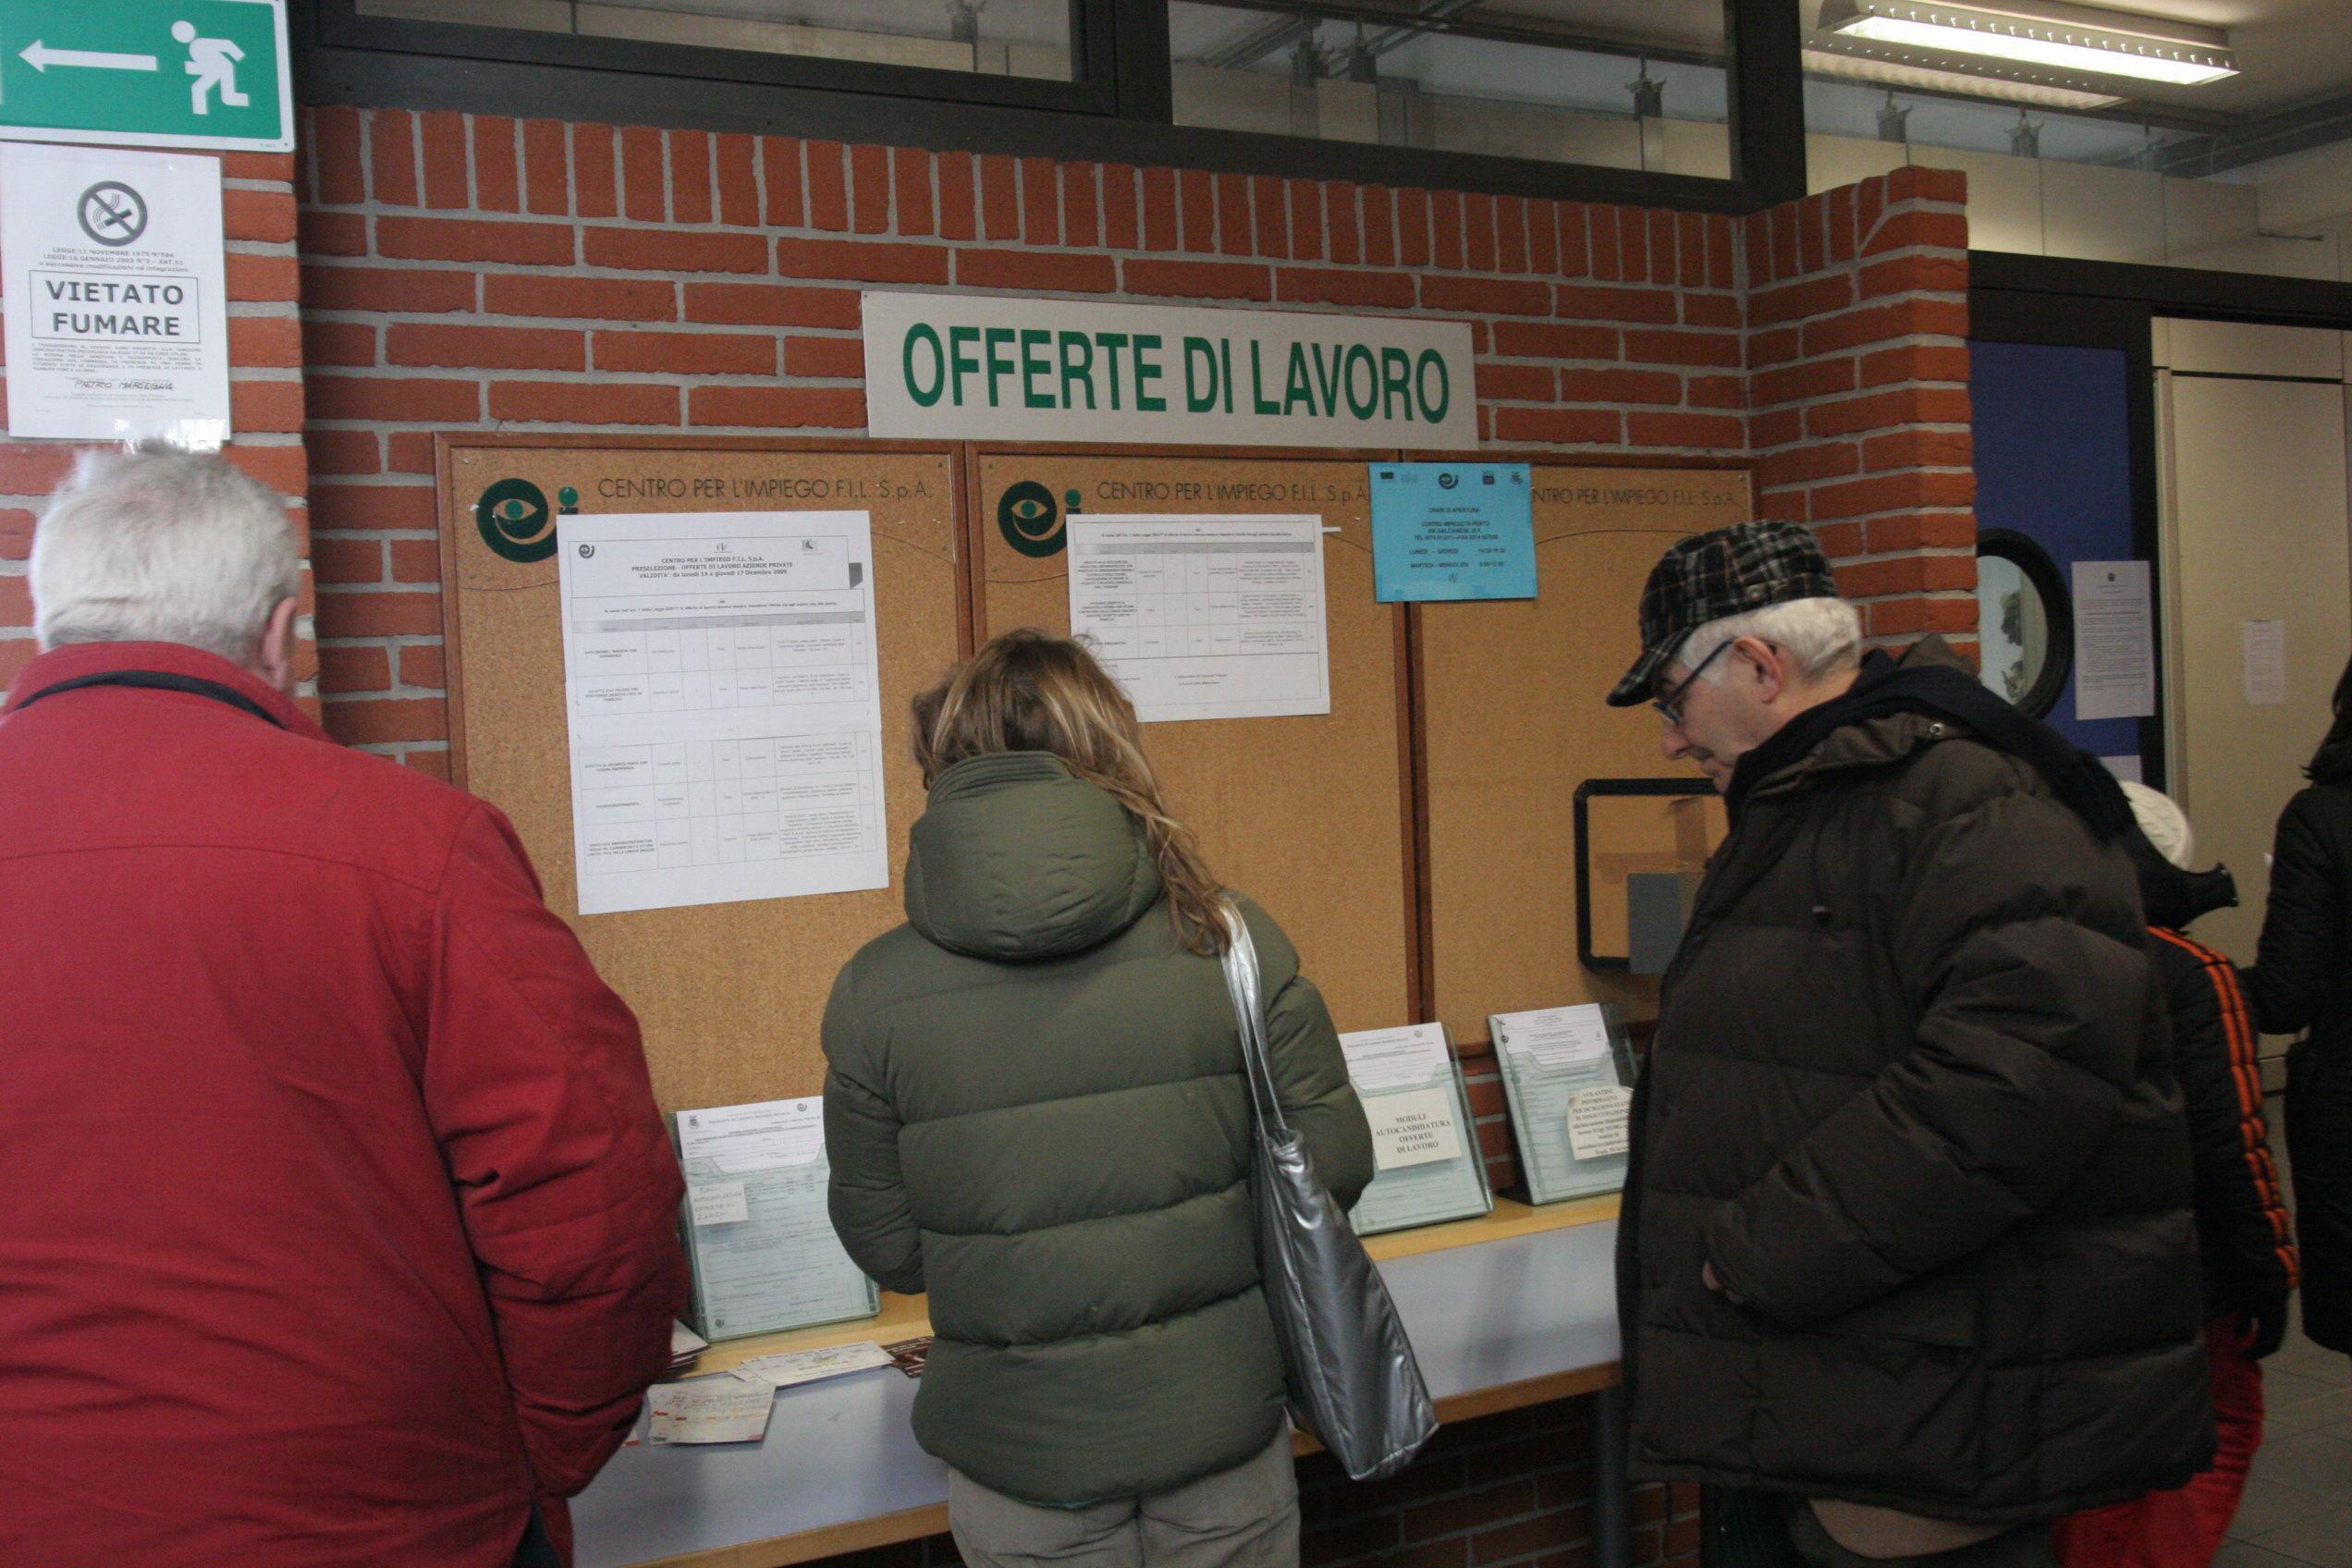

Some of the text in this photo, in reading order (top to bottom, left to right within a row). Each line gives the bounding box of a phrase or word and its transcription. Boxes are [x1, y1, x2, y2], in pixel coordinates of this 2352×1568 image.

[44, 279, 184, 305] VIETATO
[52, 312, 180, 337] FUMARE
[902, 322, 1450, 424] OFFERTE DI LAVORO
[597, 477, 690, 499] CENTRO
[693, 478, 726, 498] PER
[733, 478, 829, 499] L'IMPIEGO
[1096, 480, 1170, 500] CENTRO
[1175, 482, 1202, 501] PER
[1207, 483, 1287, 502] L'IMPIEGO
[1531, 488, 1572, 504] NTRO
[1576, 488, 1599, 504] PER
[1395, 1112, 1427, 1124] MODULI
[1376, 1120, 1451, 1136] AUTOCANDIDATURA
[1397, 1141, 1439, 1154] DI LAVORO
[1399, 1133, 1433, 1144] OFFERTE
